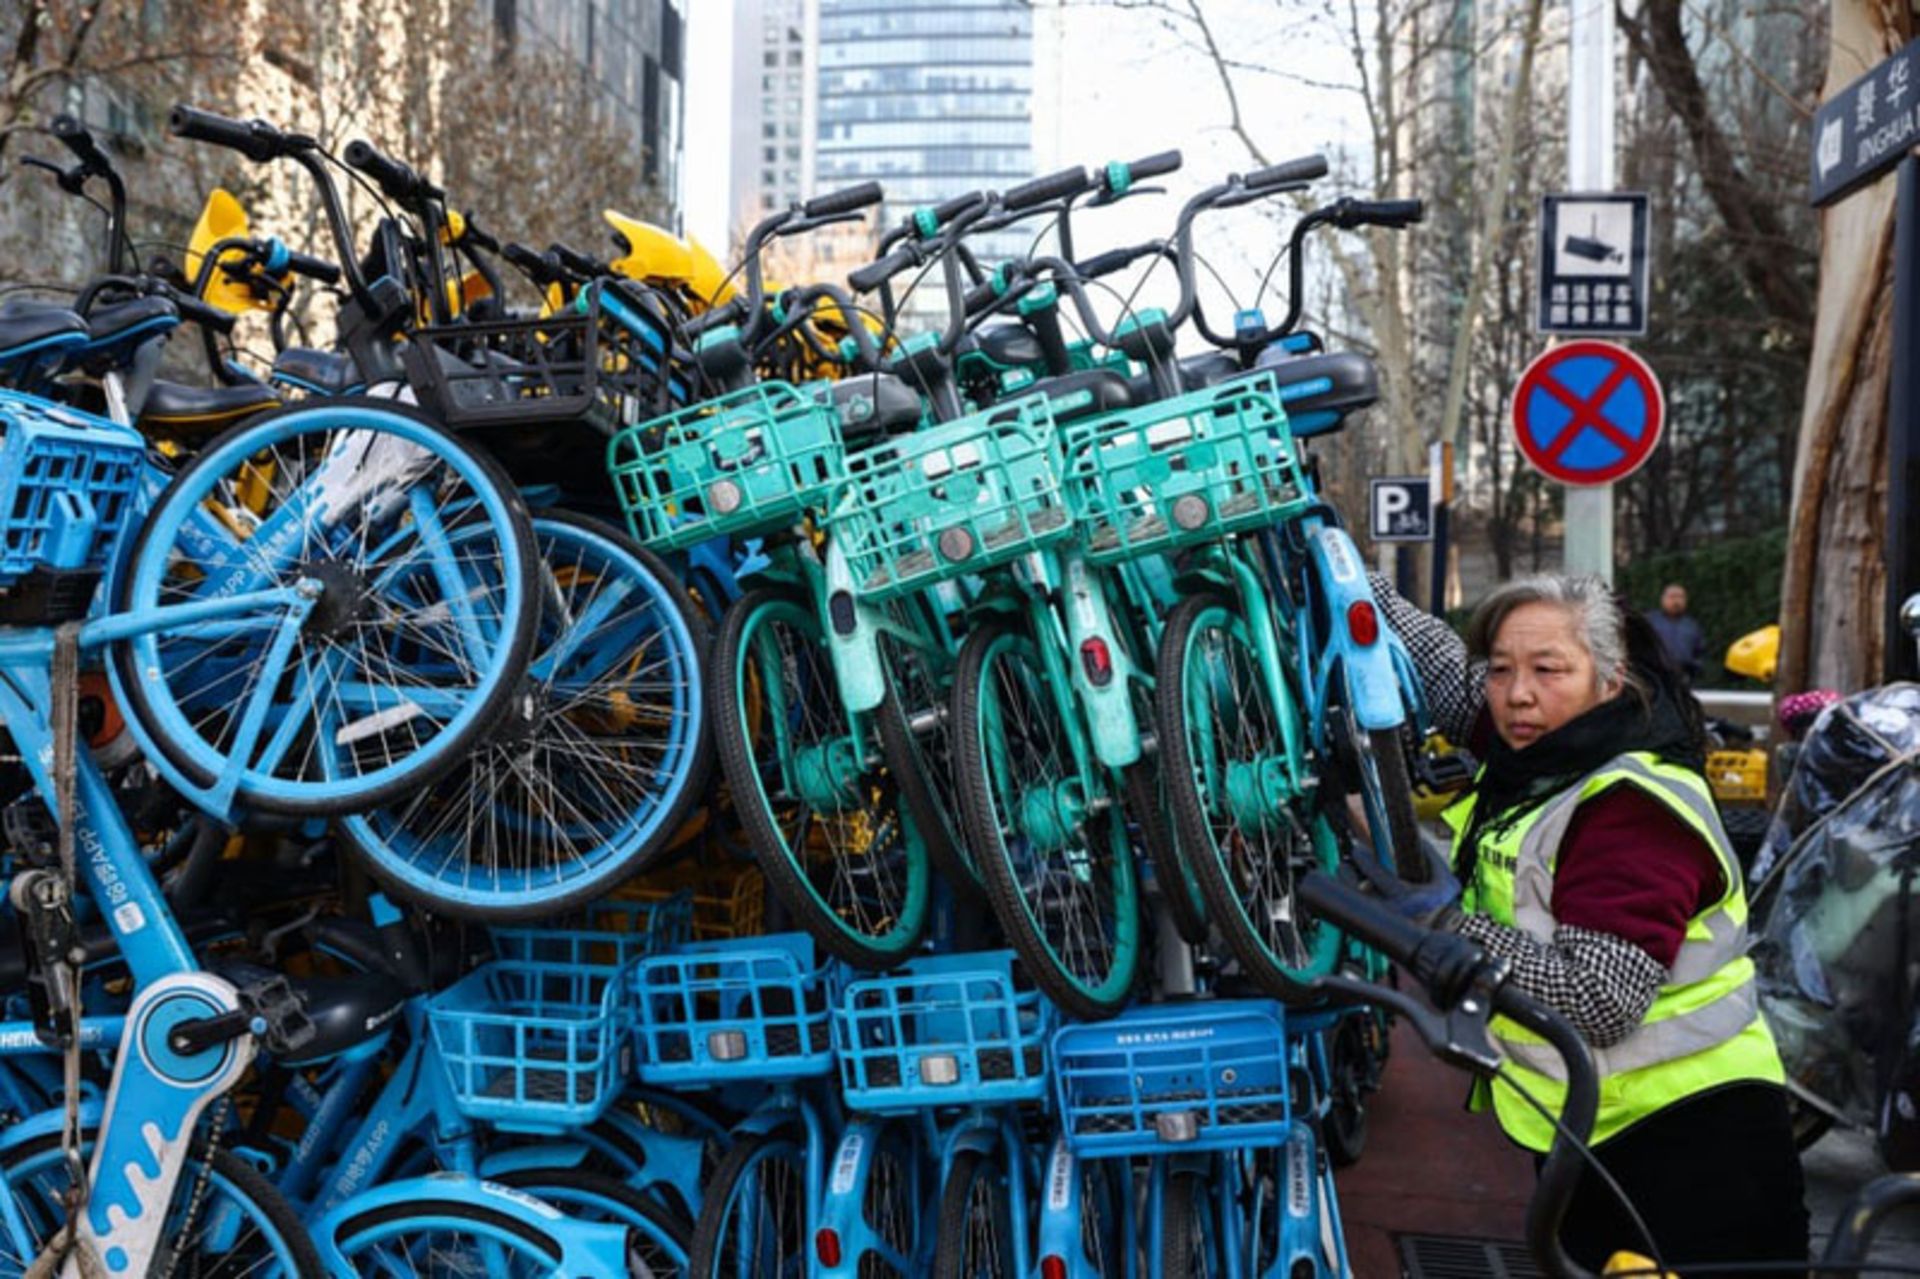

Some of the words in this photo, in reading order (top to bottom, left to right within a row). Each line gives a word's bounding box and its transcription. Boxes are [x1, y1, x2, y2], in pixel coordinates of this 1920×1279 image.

[1551, 284, 1632, 303] 违法停车
[1377, 485, 1410, 534] P
